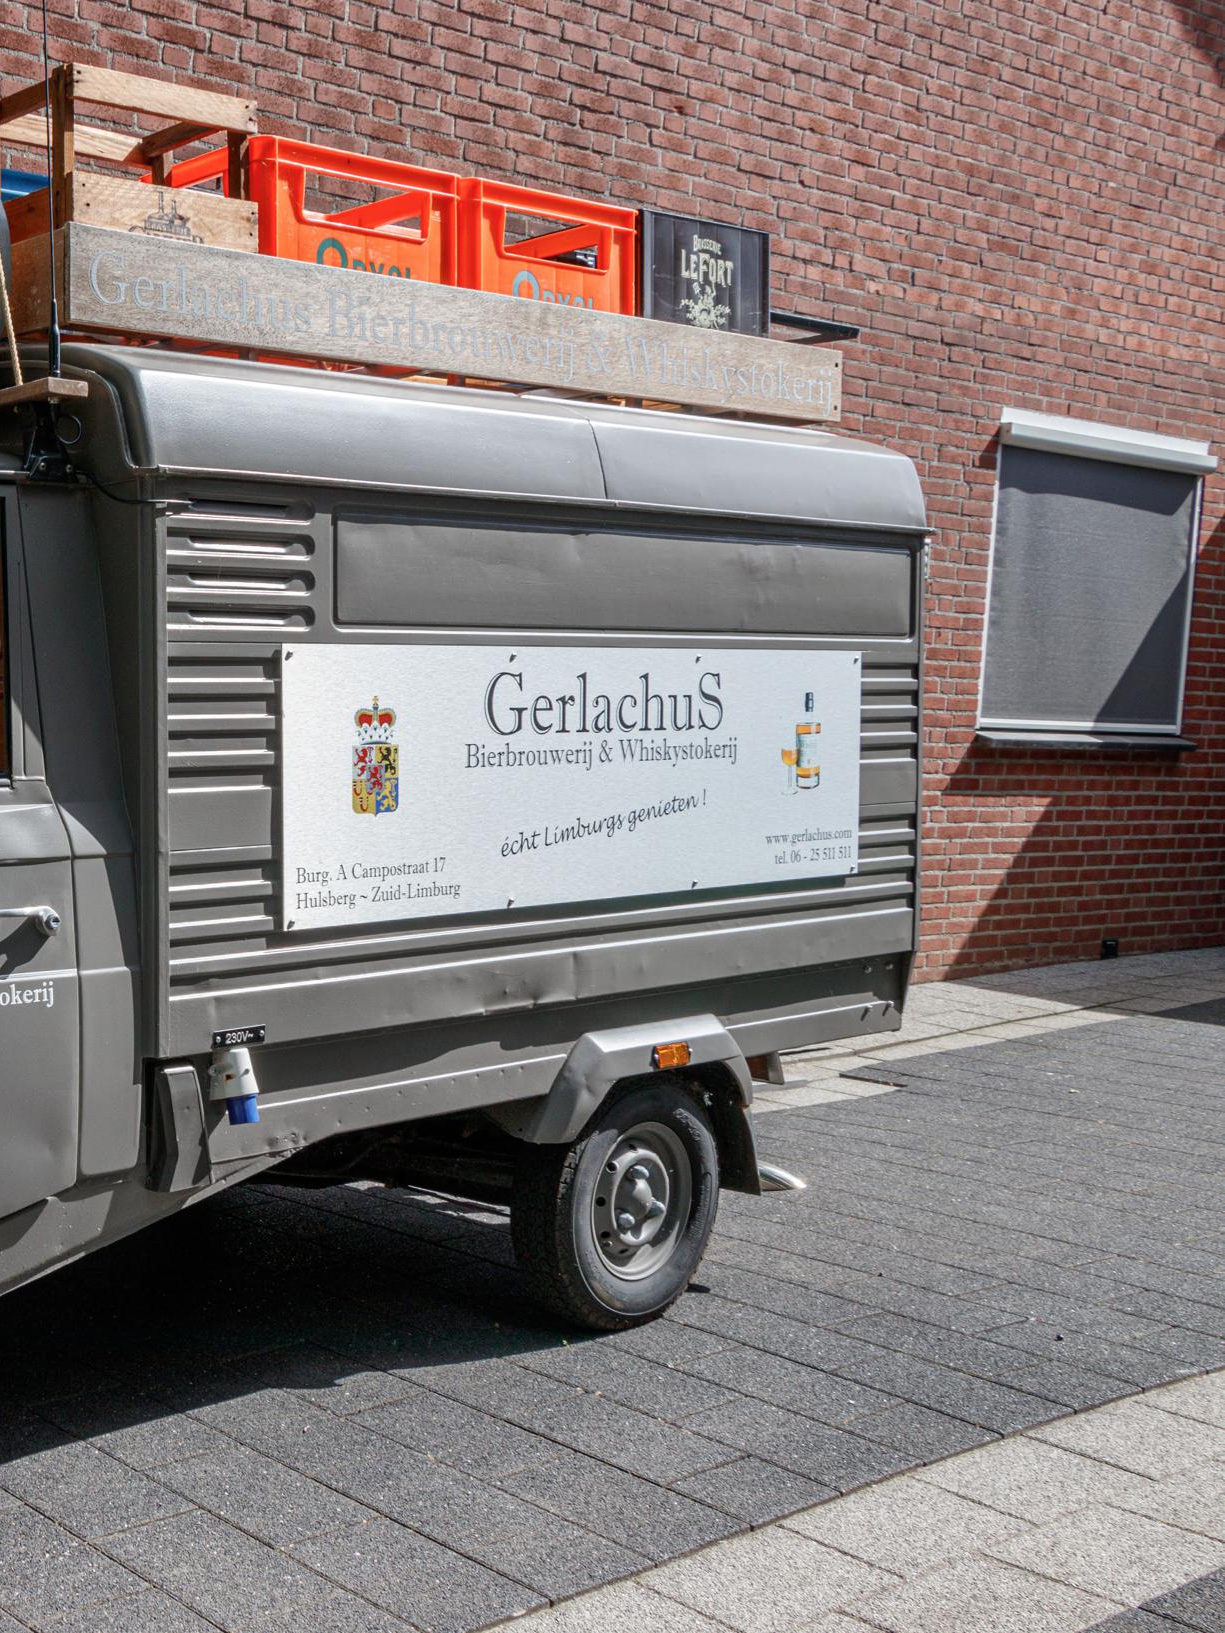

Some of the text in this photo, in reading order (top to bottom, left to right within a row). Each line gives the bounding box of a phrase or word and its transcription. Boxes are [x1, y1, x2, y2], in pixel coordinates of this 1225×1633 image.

[88, 250, 833, 416] Gerlachus Bierbrouwerij & Whiskystokerij
[484, 671, 723, 735] GerlachuS
[465, 736, 738, 771] Bierbrouwerij & Whiskystokerij
[501, 832, 542, 857] écht
[544, 815, 625, 847] Limburgs
[627, 795, 700, 832] genieten
[765, 827, 853, 846] www.gerlachus.com
[296, 856, 447, 886] Burg. A Campostraat 17
[774, 850, 789, 865] tel.
[790, 849, 802, 864] 06
[810, 847, 820, 862] 25
[822, 846, 836, 861] 511
[838, 845, 852, 859] 511
[296, 890, 356, 909] Hulsberg
[371, 881, 461, 903] Zuid-Limburg
